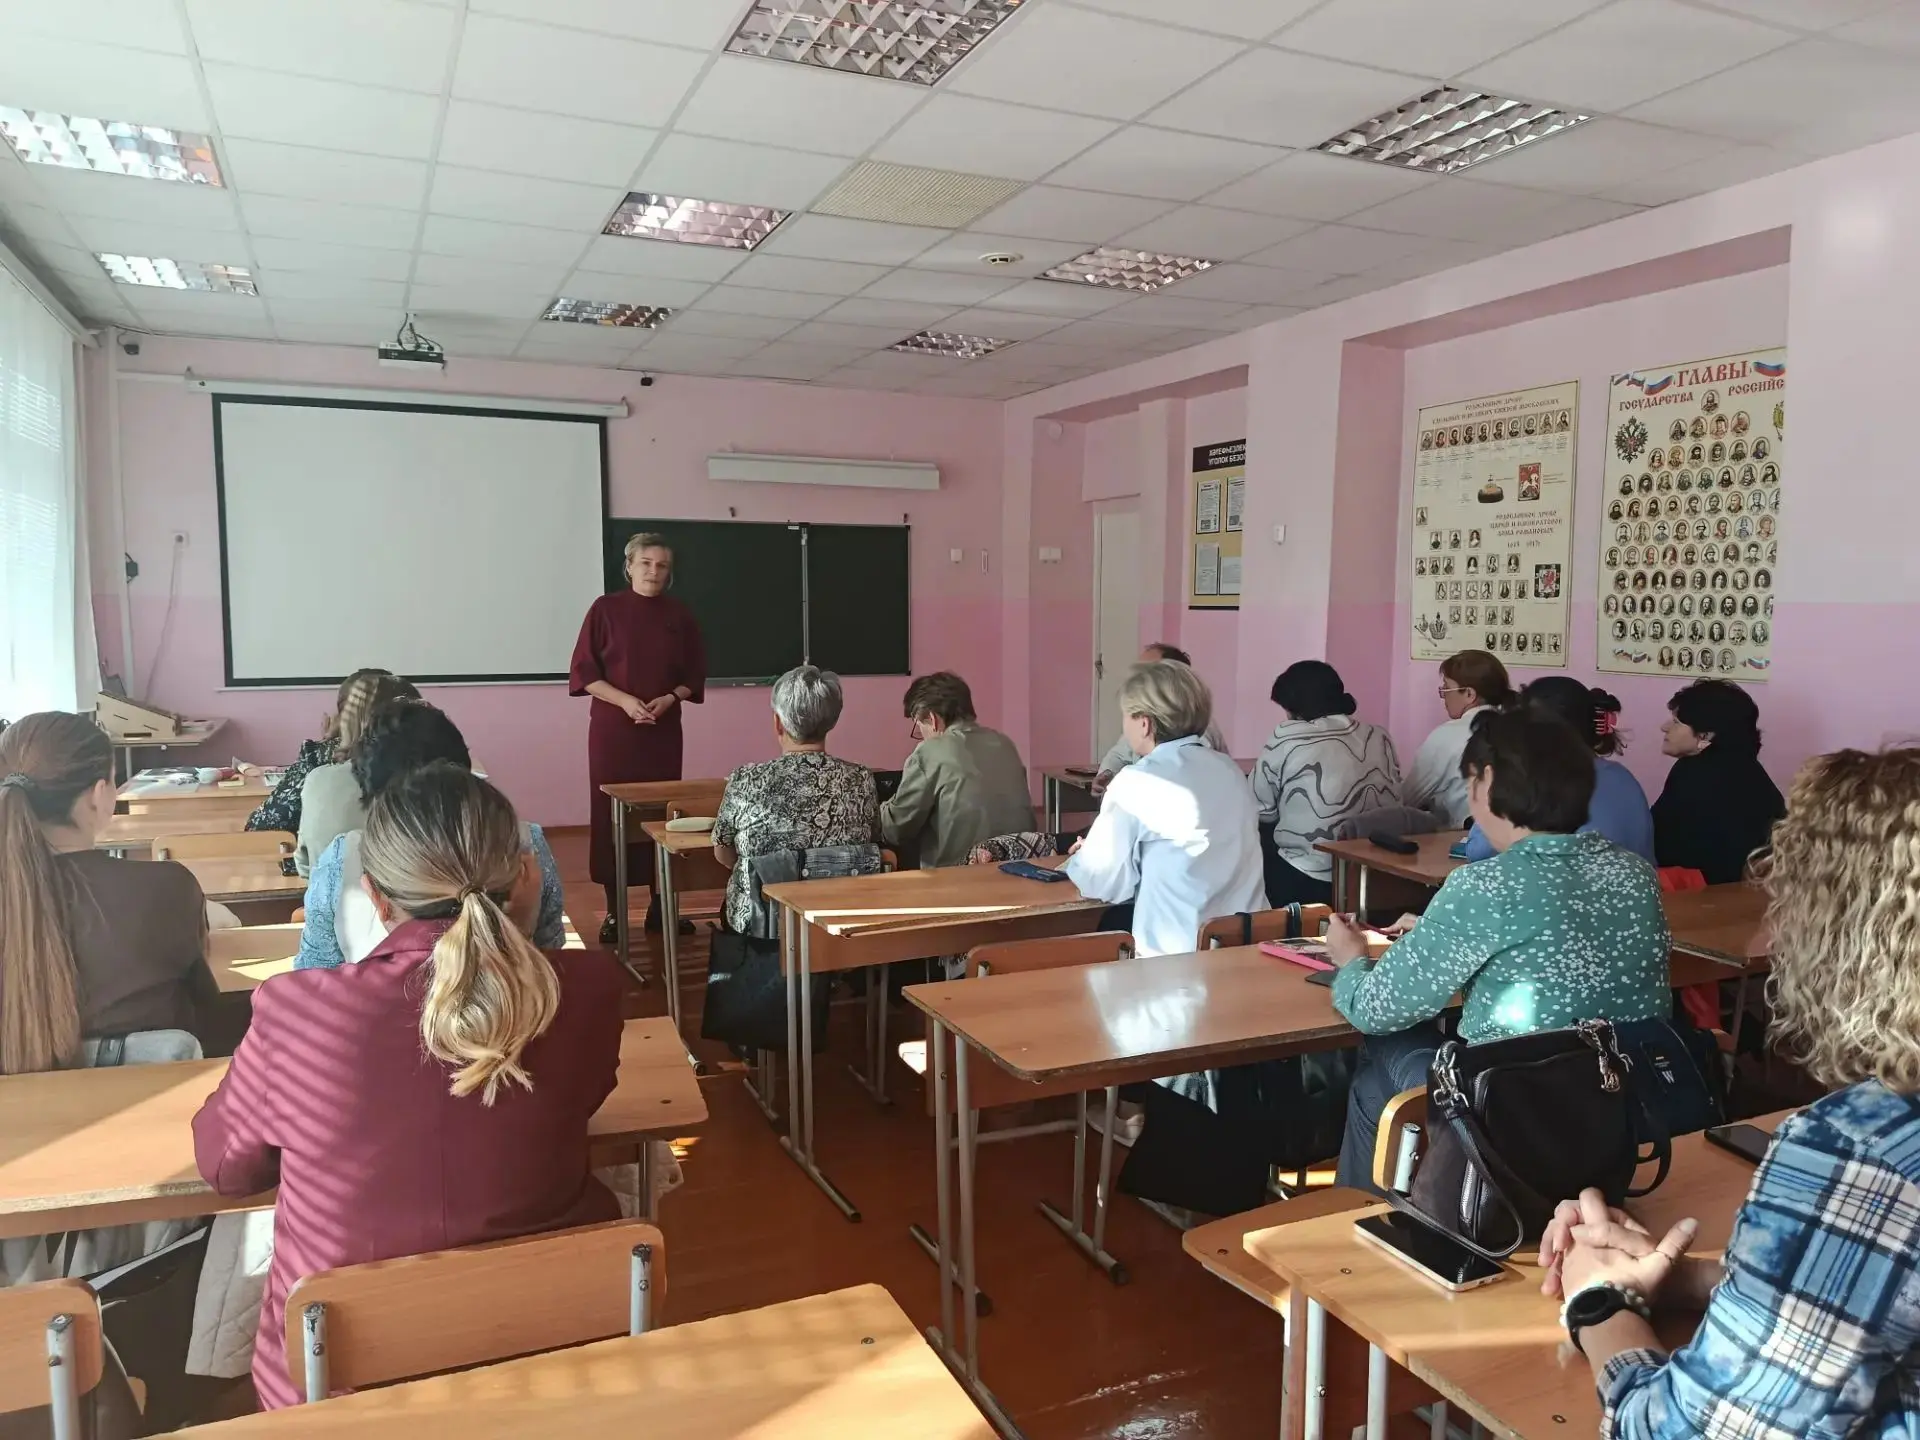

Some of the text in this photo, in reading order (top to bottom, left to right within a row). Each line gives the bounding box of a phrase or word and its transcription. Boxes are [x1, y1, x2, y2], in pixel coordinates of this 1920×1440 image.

[1677, 360, 1748, 388] ГЛАВЫ
[1618, 391, 1694, 412] ГОСУДАРСТВА
[1230, 453, 1246, 463] БЕЗО
